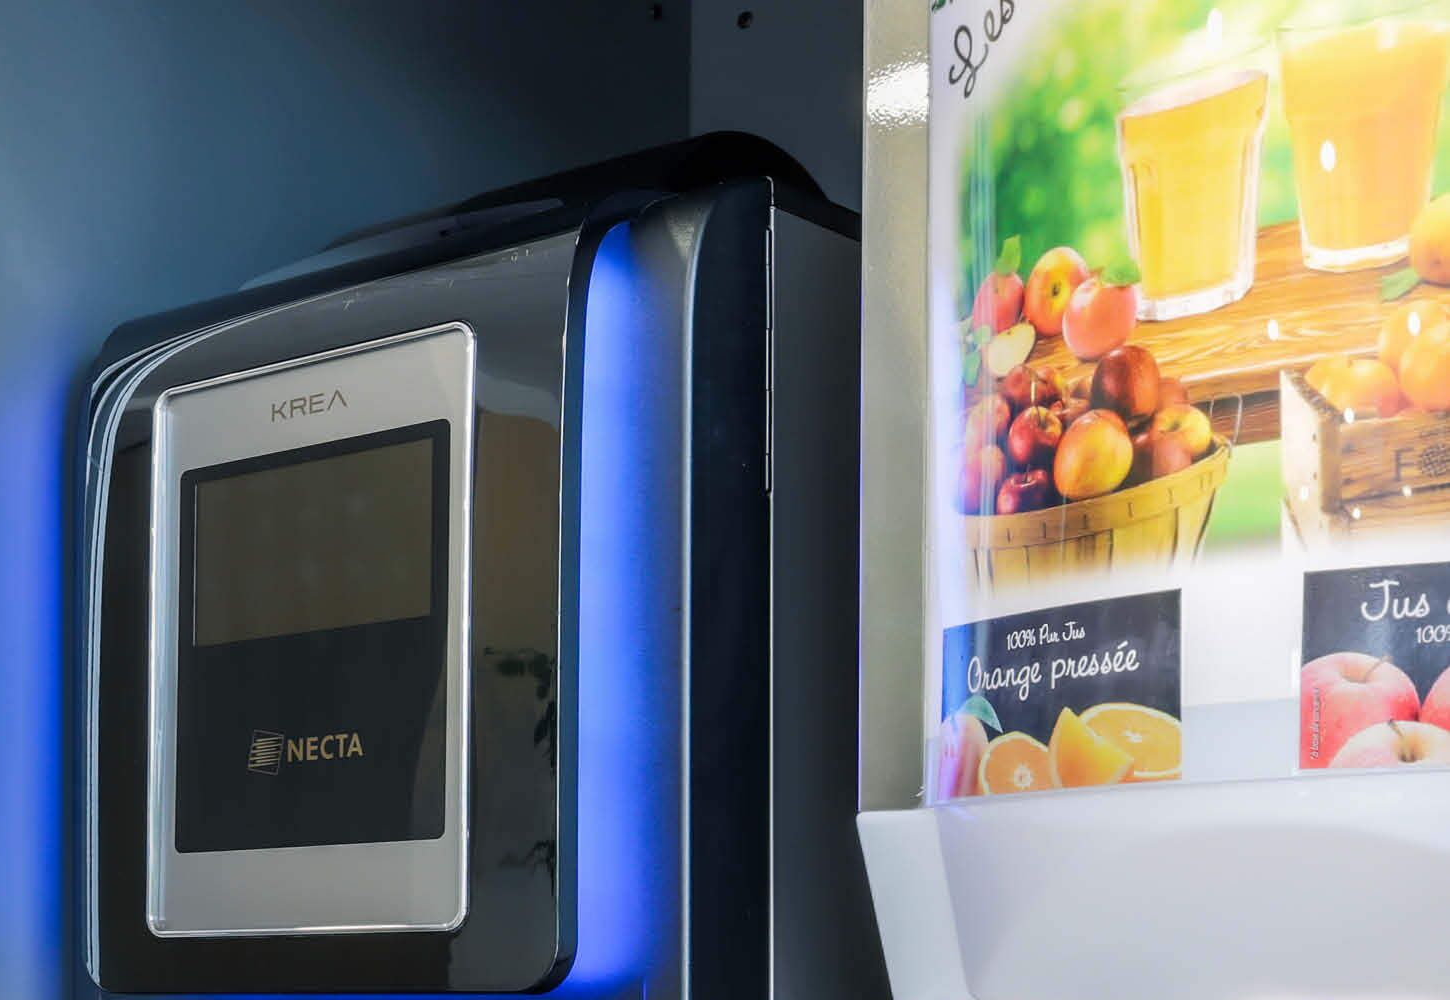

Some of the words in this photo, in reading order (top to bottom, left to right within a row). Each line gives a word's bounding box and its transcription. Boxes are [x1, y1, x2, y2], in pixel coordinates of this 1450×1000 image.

[271, 389, 348, 422] KREA
[1360, 579, 1430, 621] Jus
[1006, 629, 1036, 651] 100%
[1040, 623, 1060, 646] Pur
[1063, 620, 1086, 642] Jus
[967, 656, 1042, 701] Orange
[1051, 640, 1140, 689] pressée
[287, 732, 363, 762] NECTA
